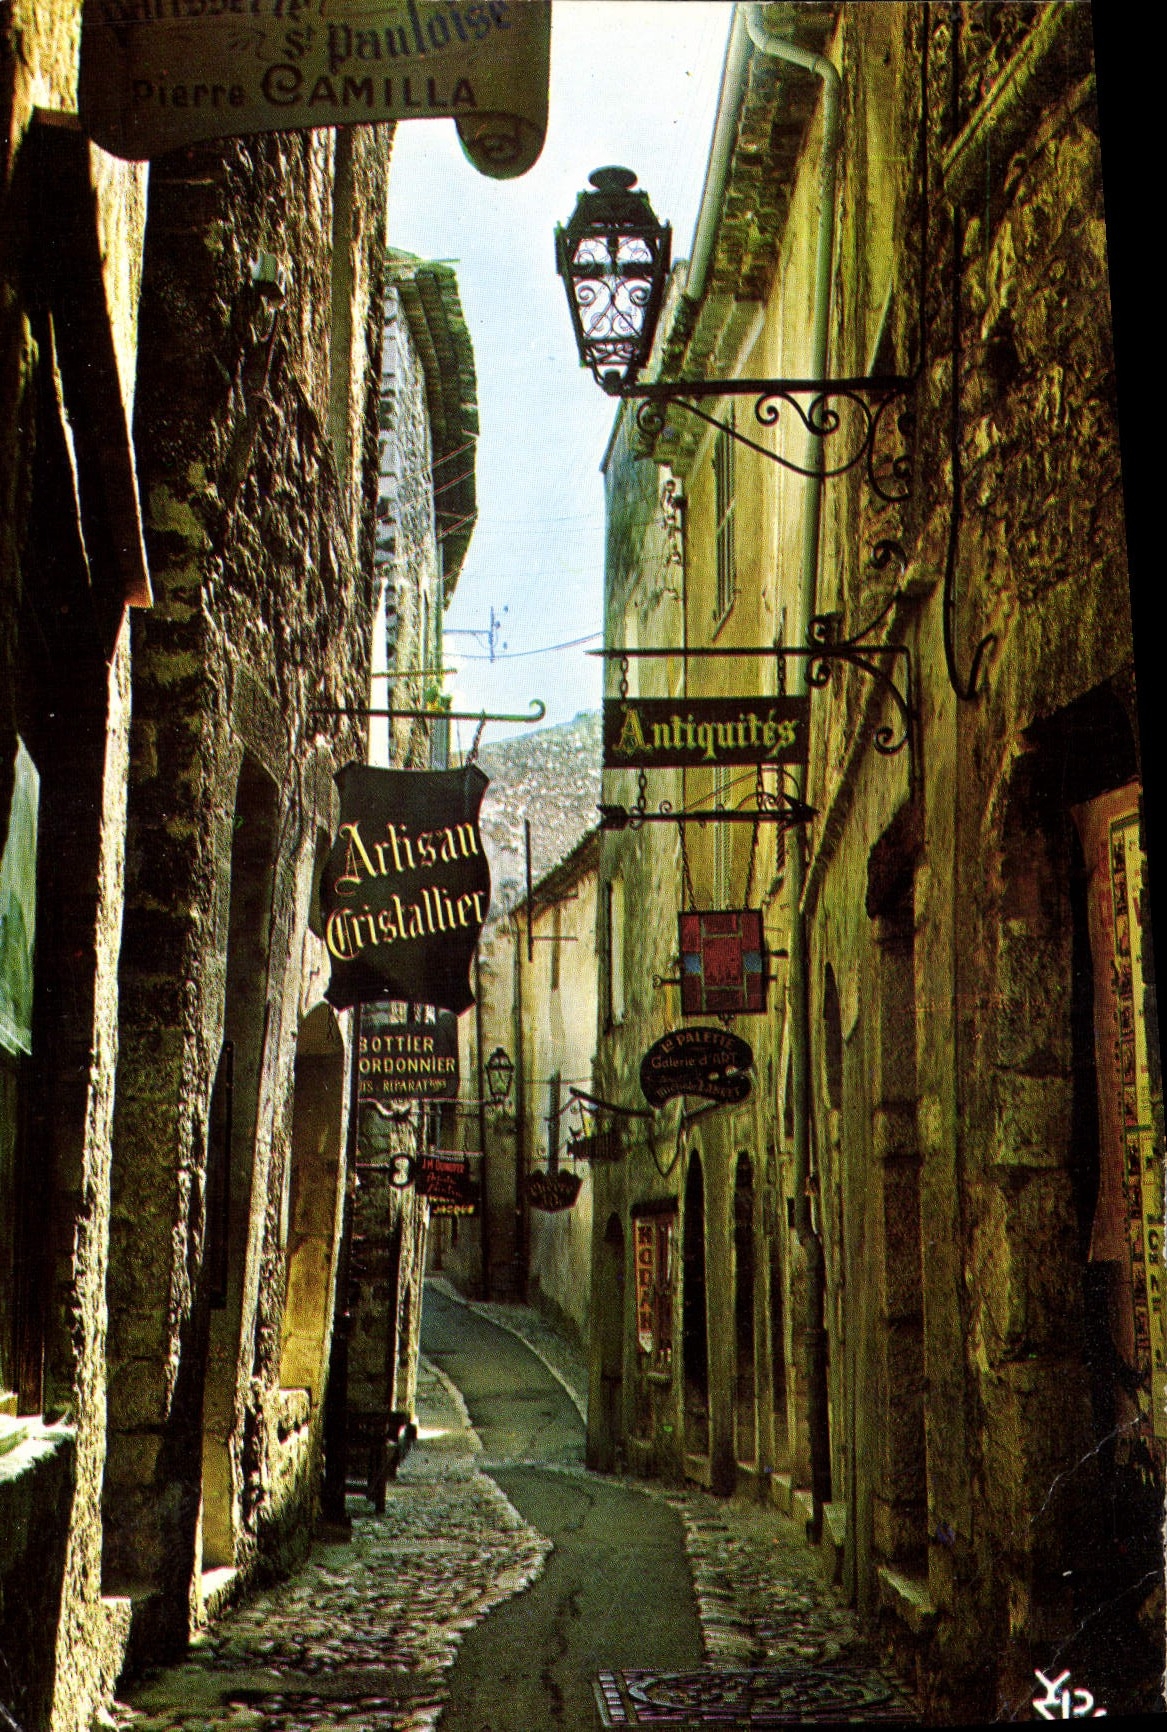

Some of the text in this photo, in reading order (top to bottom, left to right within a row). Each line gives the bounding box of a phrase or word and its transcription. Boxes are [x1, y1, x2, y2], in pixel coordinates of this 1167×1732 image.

[132, 64, 479, 110] Pierre CAMILLA
[612, 702, 799, 760] Antiquités
[336, 821, 478, 896] Artisan
[326, 886, 487, 961] Cristallier
[359, 1054, 455, 1075] ORDONNIER
[676, 1031, 735, 1050] PALETTE
